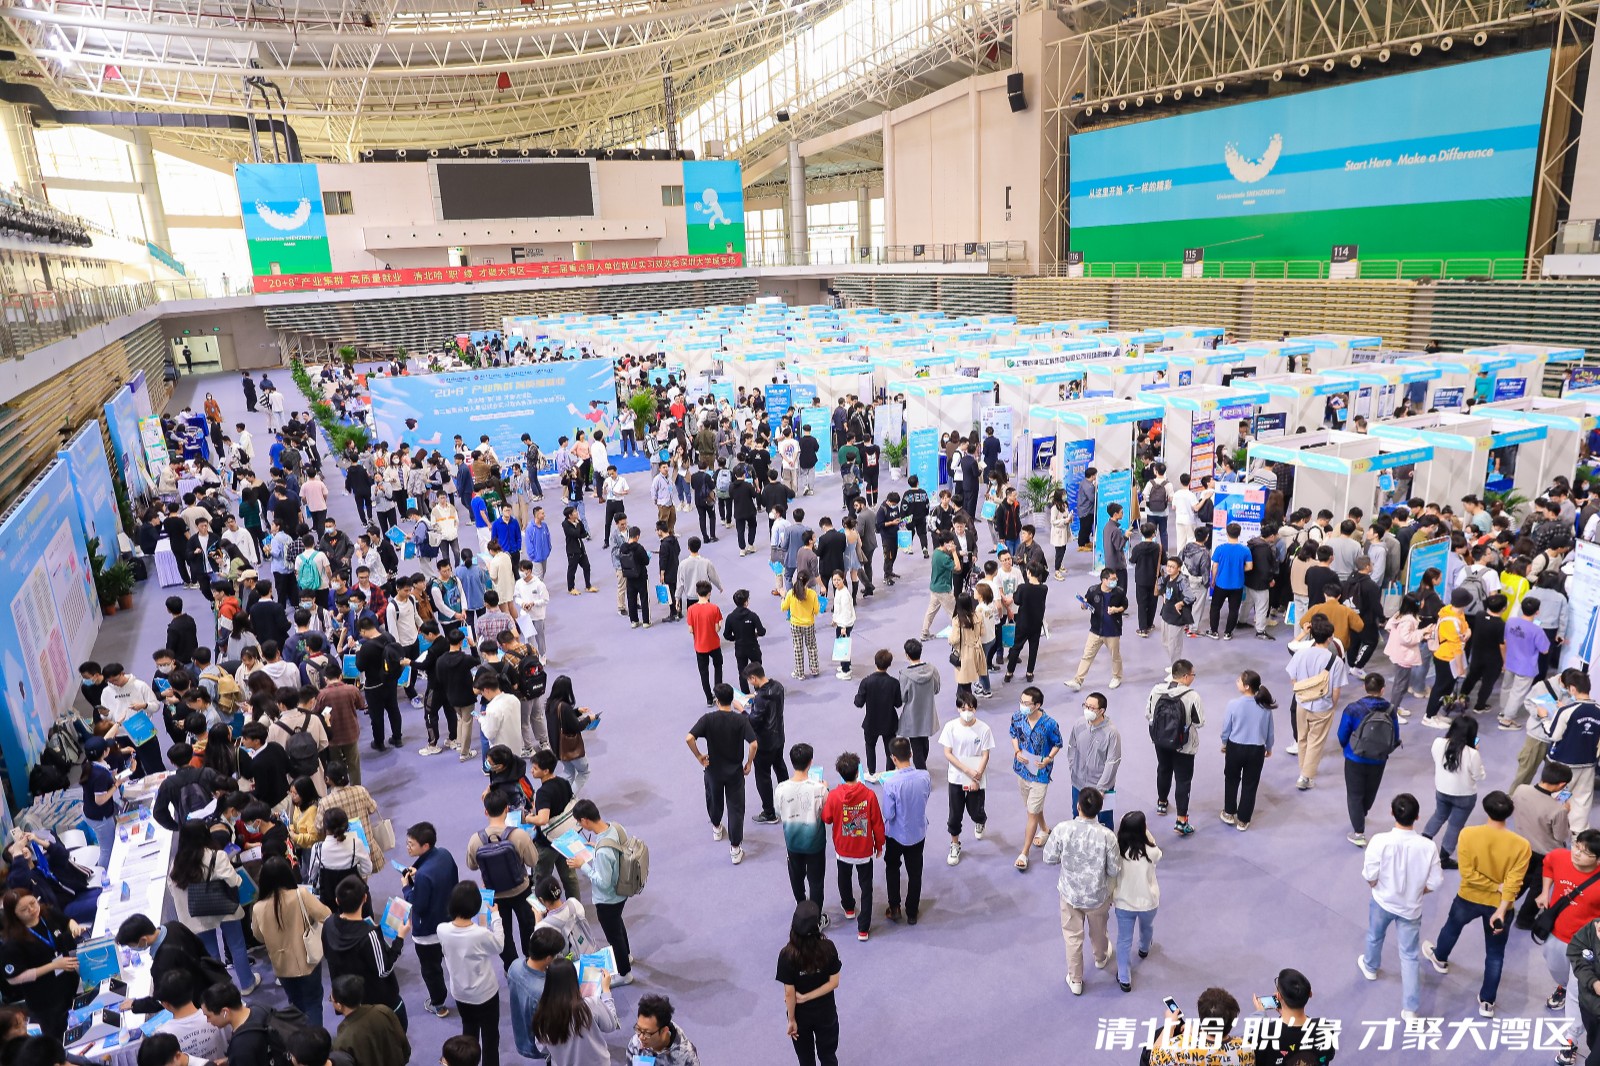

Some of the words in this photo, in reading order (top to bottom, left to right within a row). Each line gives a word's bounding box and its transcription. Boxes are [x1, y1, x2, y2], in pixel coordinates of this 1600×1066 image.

[1344, 159, 1367, 171] Start
[1368, 157, 1392, 169] Here
[1397, 152, 1426, 166] Make
[1428, 155, 1436, 163] a
[1437, 146, 1494, 162] Difference
[1088, 185, 1123, 199] 从这里开始
[1126, 179, 1173, 195] 不一样的精彩
[1069, 252, 1079, 260] 116
[1185, 249, 1197, 259] 115
[1333, 246, 1349, 256] 114
[350, 272, 402, 284] 高质量就业
